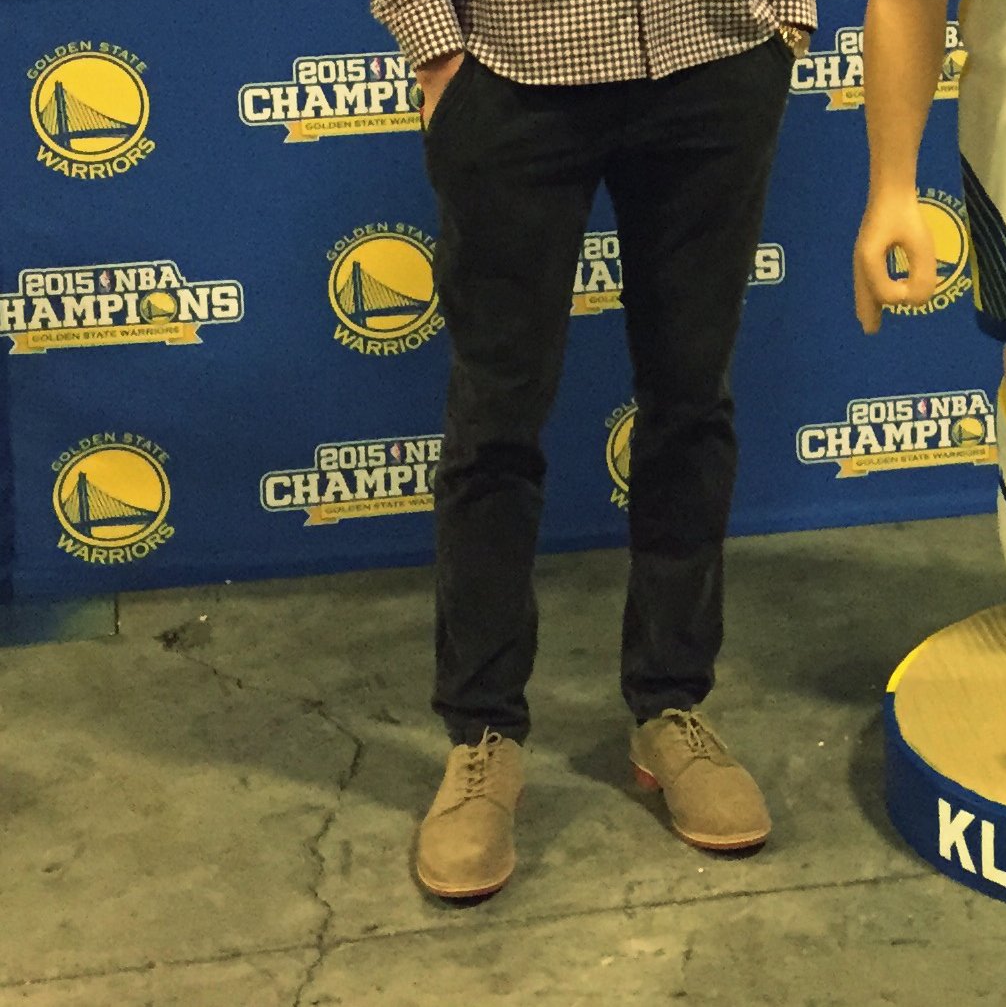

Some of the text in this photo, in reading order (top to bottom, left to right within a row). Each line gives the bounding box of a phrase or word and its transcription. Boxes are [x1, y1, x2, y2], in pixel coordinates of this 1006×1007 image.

[27, 41, 148, 79] GOLDEN STATE
[299, 59, 365, 85] 2015
[306, 121, 352, 131] GOLDEN
[354, 119, 387, 128] STATE
[37, 137, 156, 179] WARRIORS
[326, 222, 388, 261] GOLDEN
[26, 266, 180, 297] 2015 NBA
[0, 286, 239, 332] HAMPIONS
[333, 314, 447, 355] WARRIORS
[852, 394, 988, 425] 2015 NBA
[51, 434, 170, 471] GOLDEN STATE
[320, 444, 386, 471] 2015
[57, 523, 175, 563] WARRIORS
